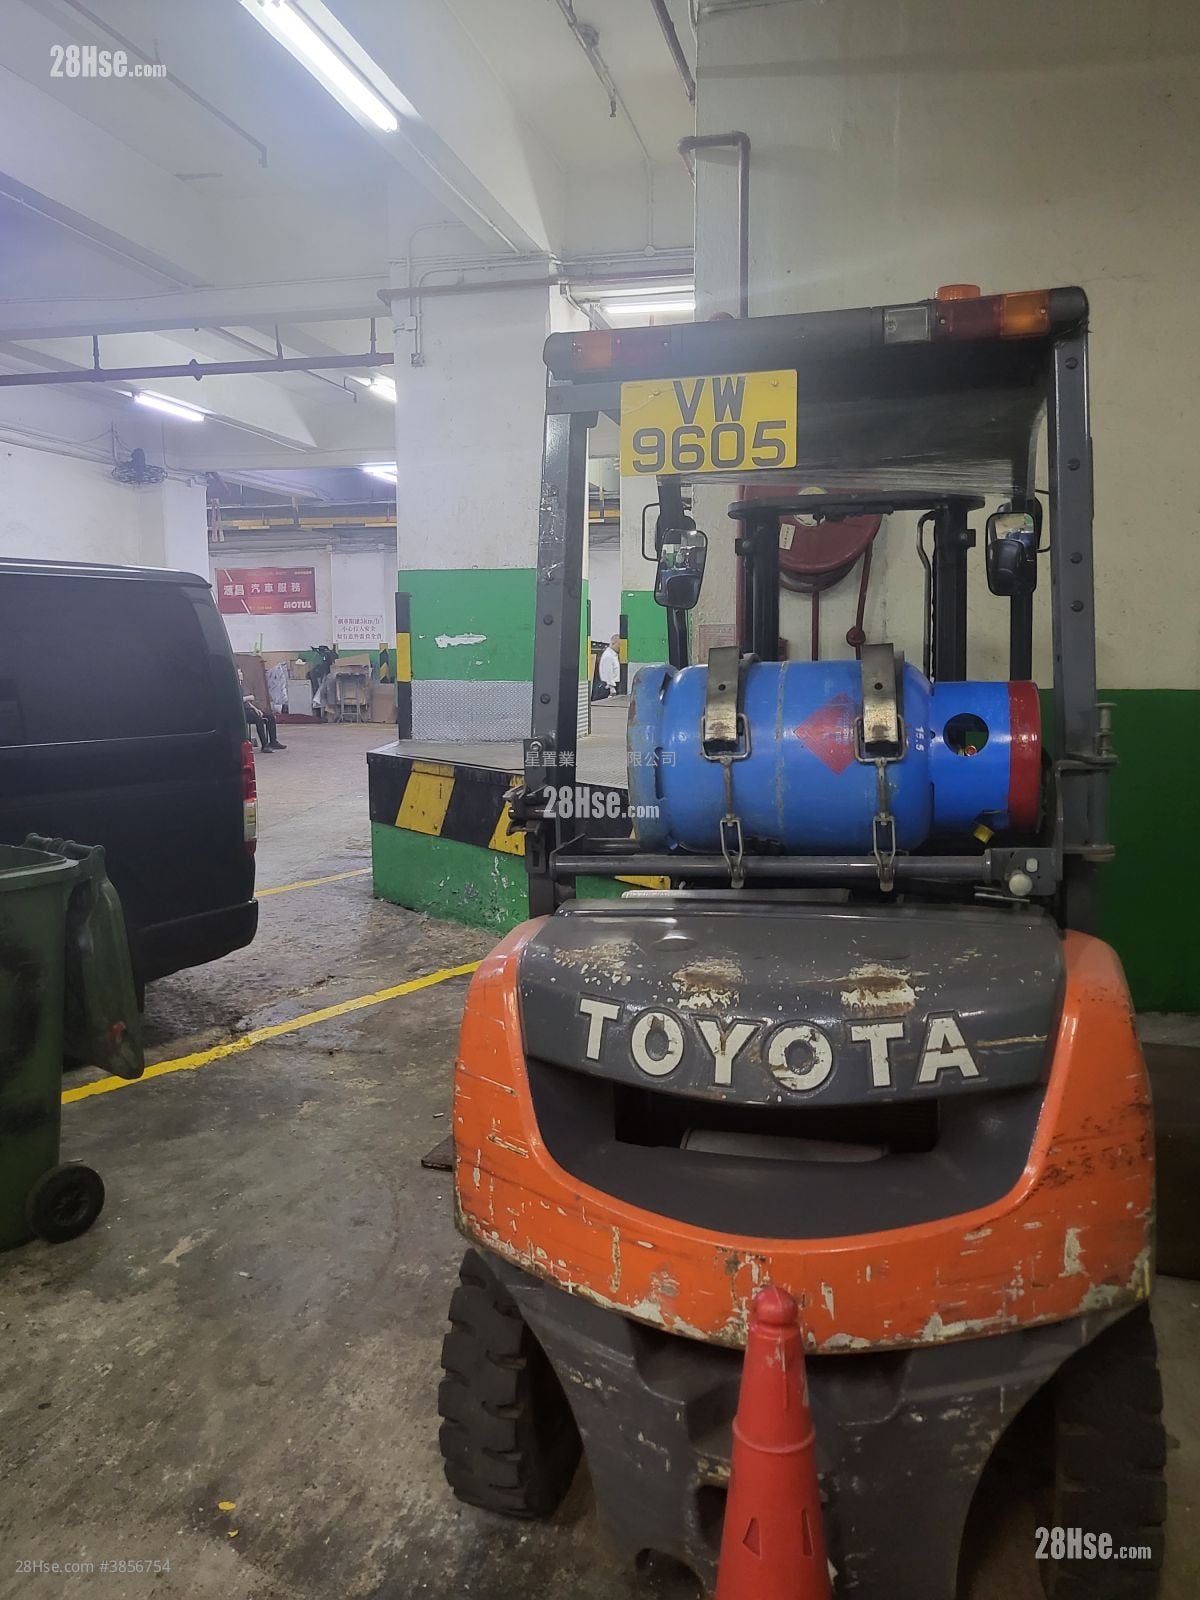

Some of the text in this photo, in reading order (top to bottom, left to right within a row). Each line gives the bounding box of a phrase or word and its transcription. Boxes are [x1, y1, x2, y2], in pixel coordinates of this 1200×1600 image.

[673, 376, 746, 424] VW
[633, 420, 787, 473] 9605
[251, 582, 301, 593] 汽車服務
[283, 601, 312, 609] MOTUL
[915, 725, 925, 751] 15.5
[579, 998, 980, 1091] TOYOTA
